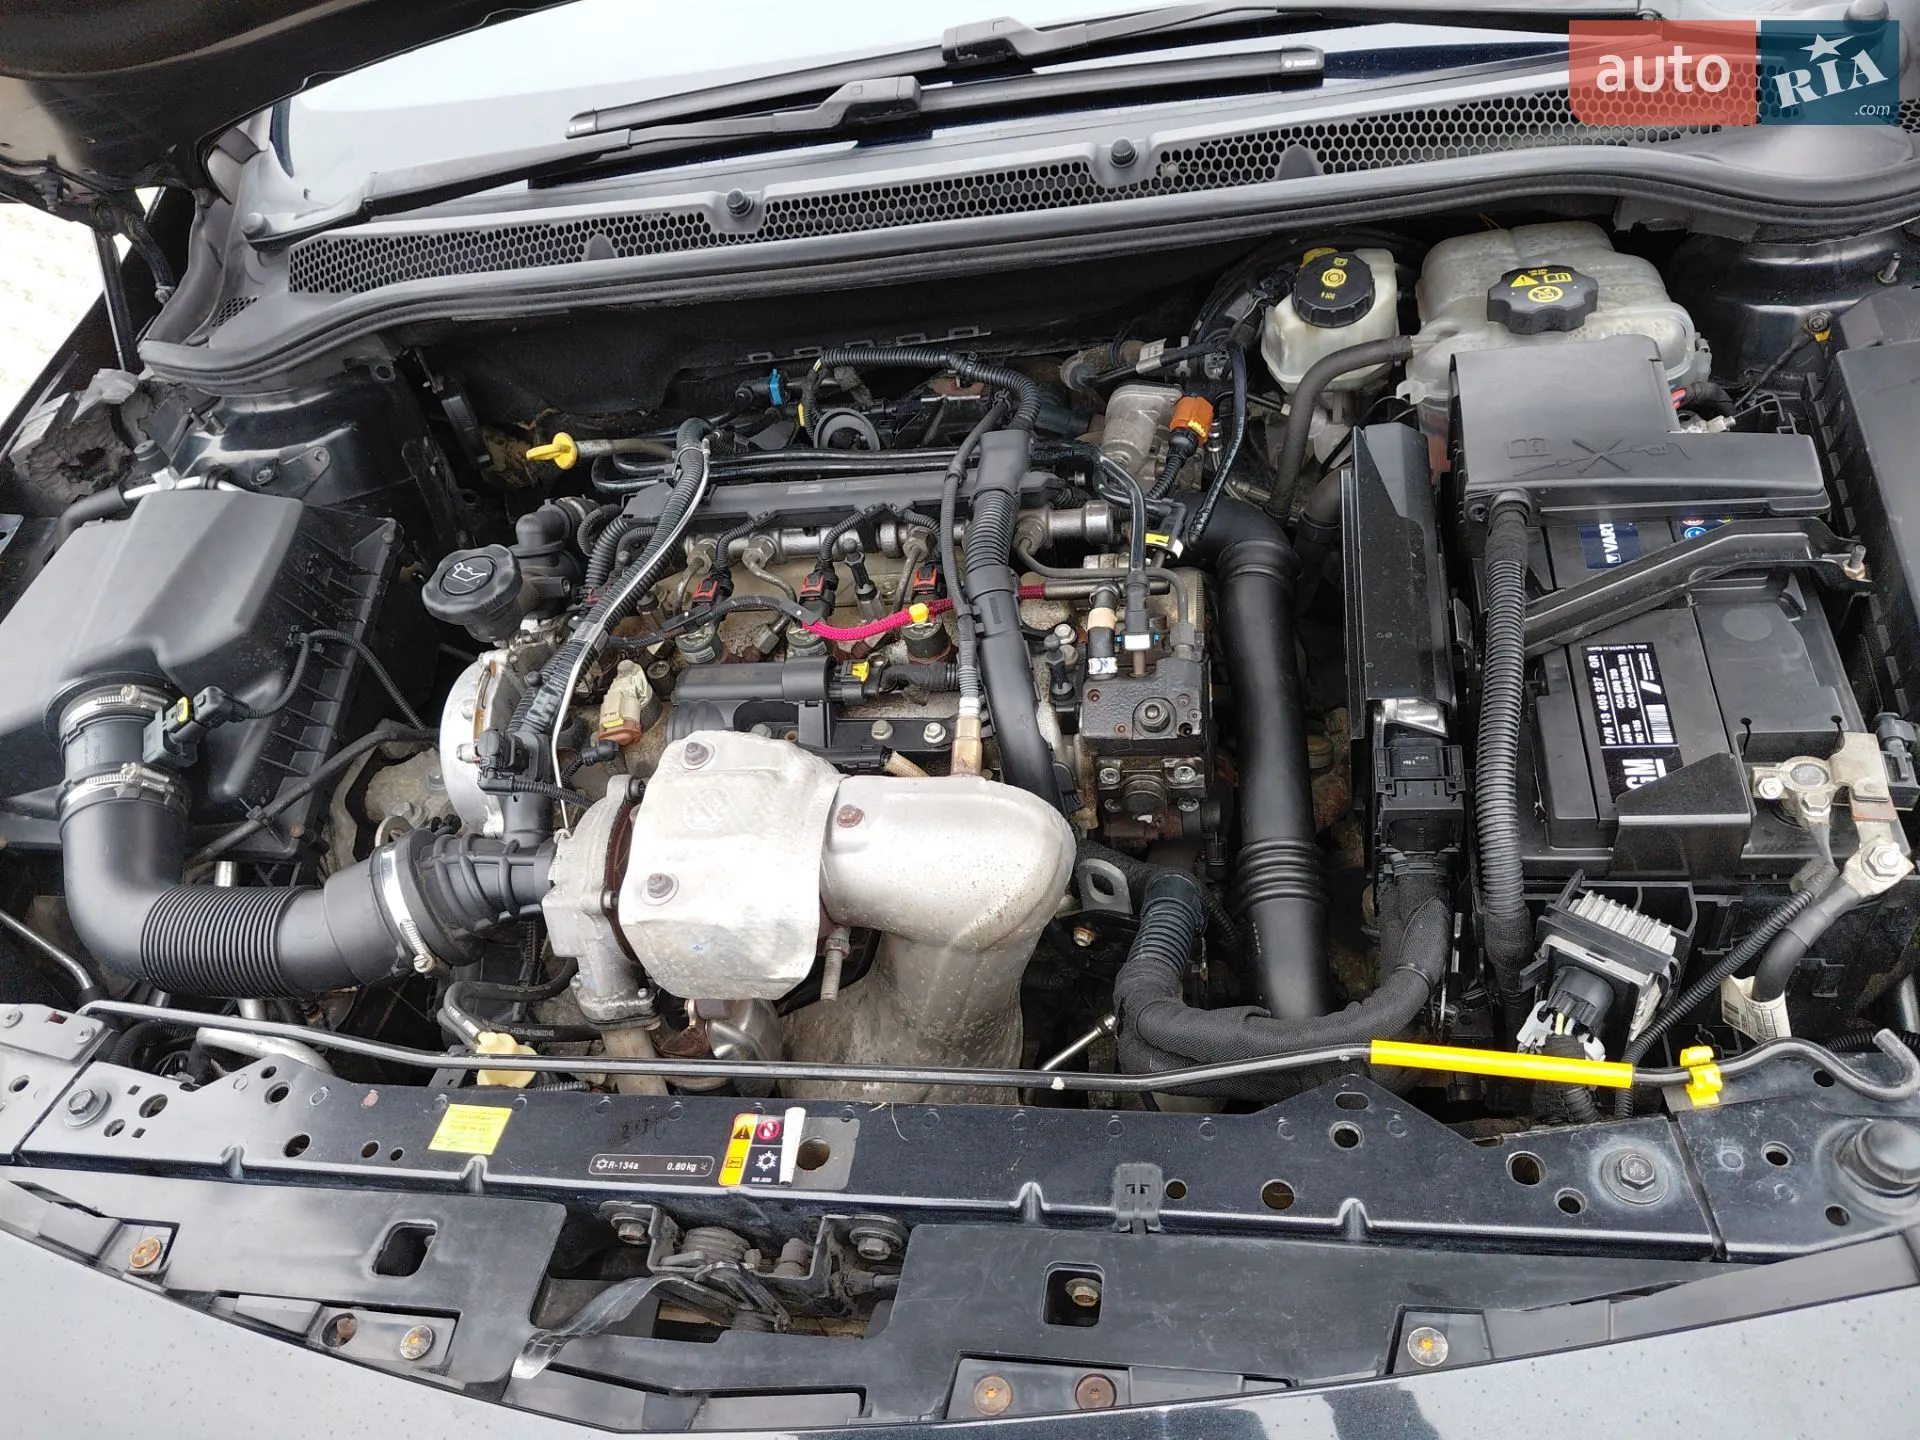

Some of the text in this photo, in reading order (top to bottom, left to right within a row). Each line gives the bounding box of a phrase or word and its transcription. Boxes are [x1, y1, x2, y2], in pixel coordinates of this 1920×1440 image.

[1588, 655, 1616, 745] P/N 13 405 237 GR
[1622, 758, 1656, 790] GM
[608, 1161, 639, 1171] R-134a
